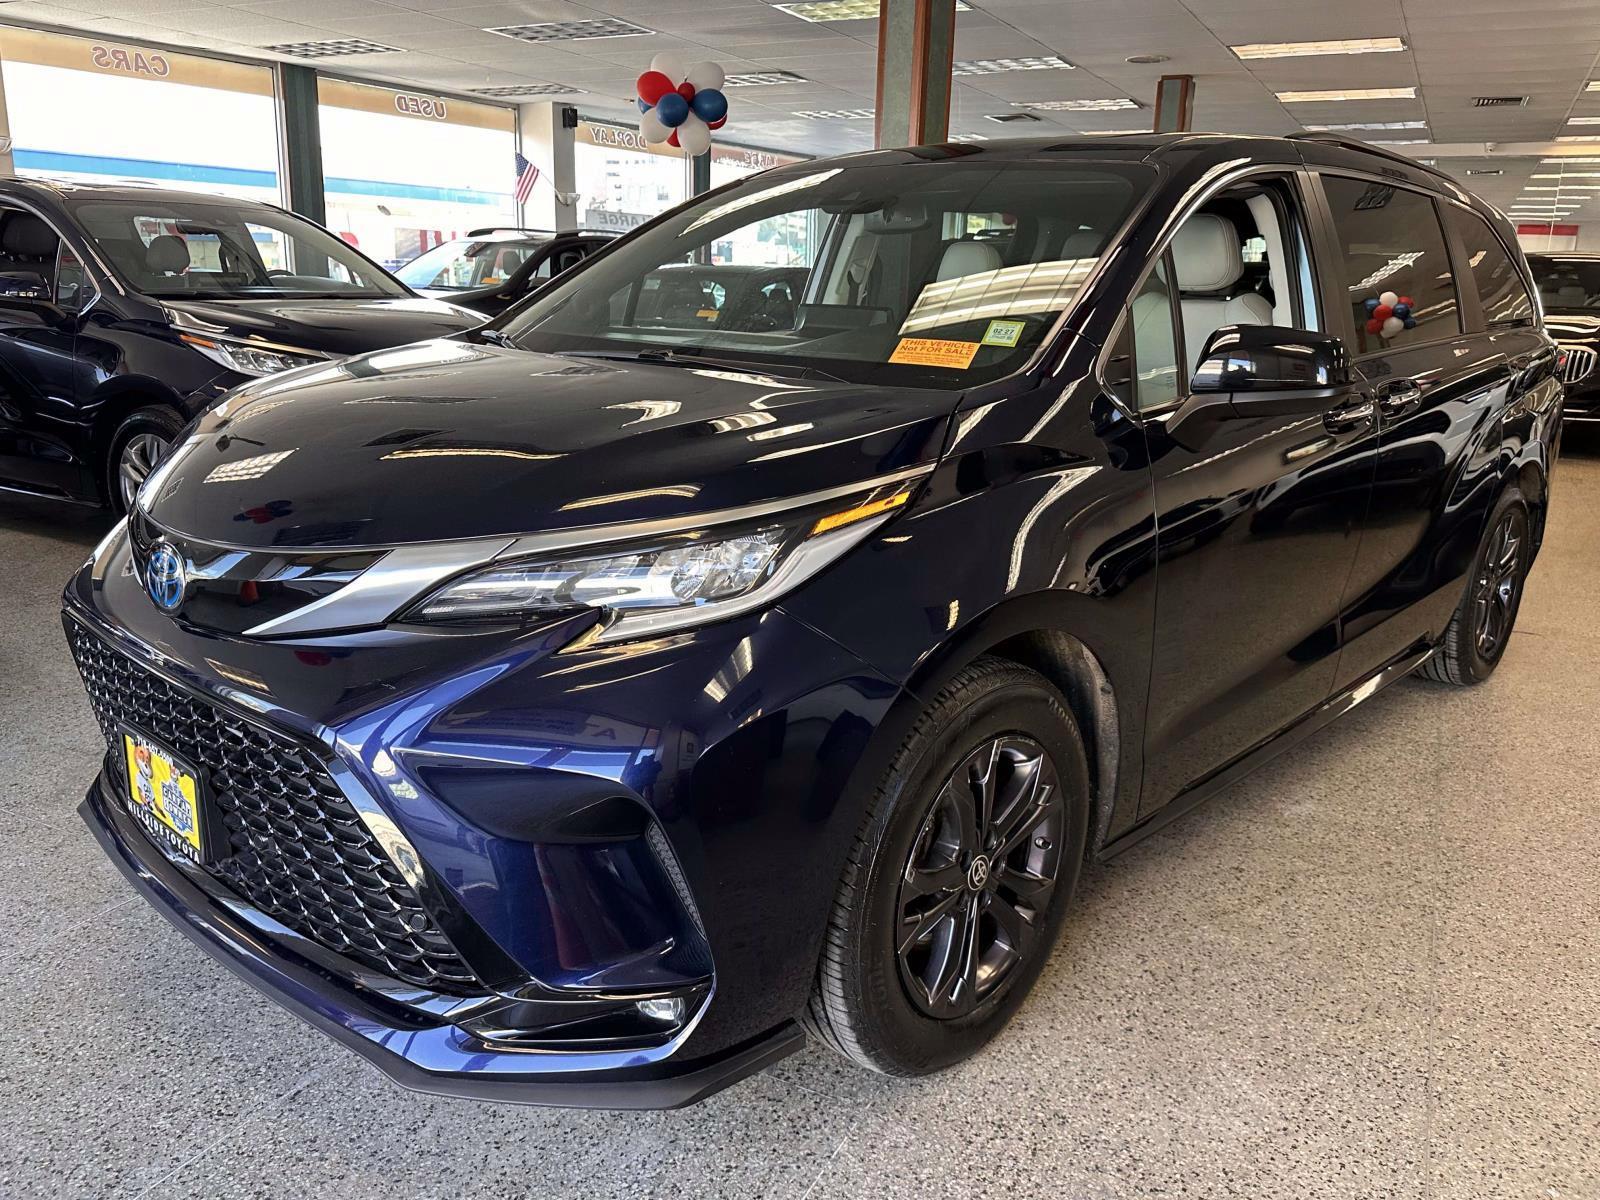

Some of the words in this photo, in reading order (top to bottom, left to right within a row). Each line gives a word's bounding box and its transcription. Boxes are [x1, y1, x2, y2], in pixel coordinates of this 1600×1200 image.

[904, 339, 928, 347] THIS
[930, 340, 976, 350] VEHICLE
[943, 347, 975, 356] SALE
[127, 800, 164, 837] HILLSIDE
[165, 829, 200, 864] TOYOTA
